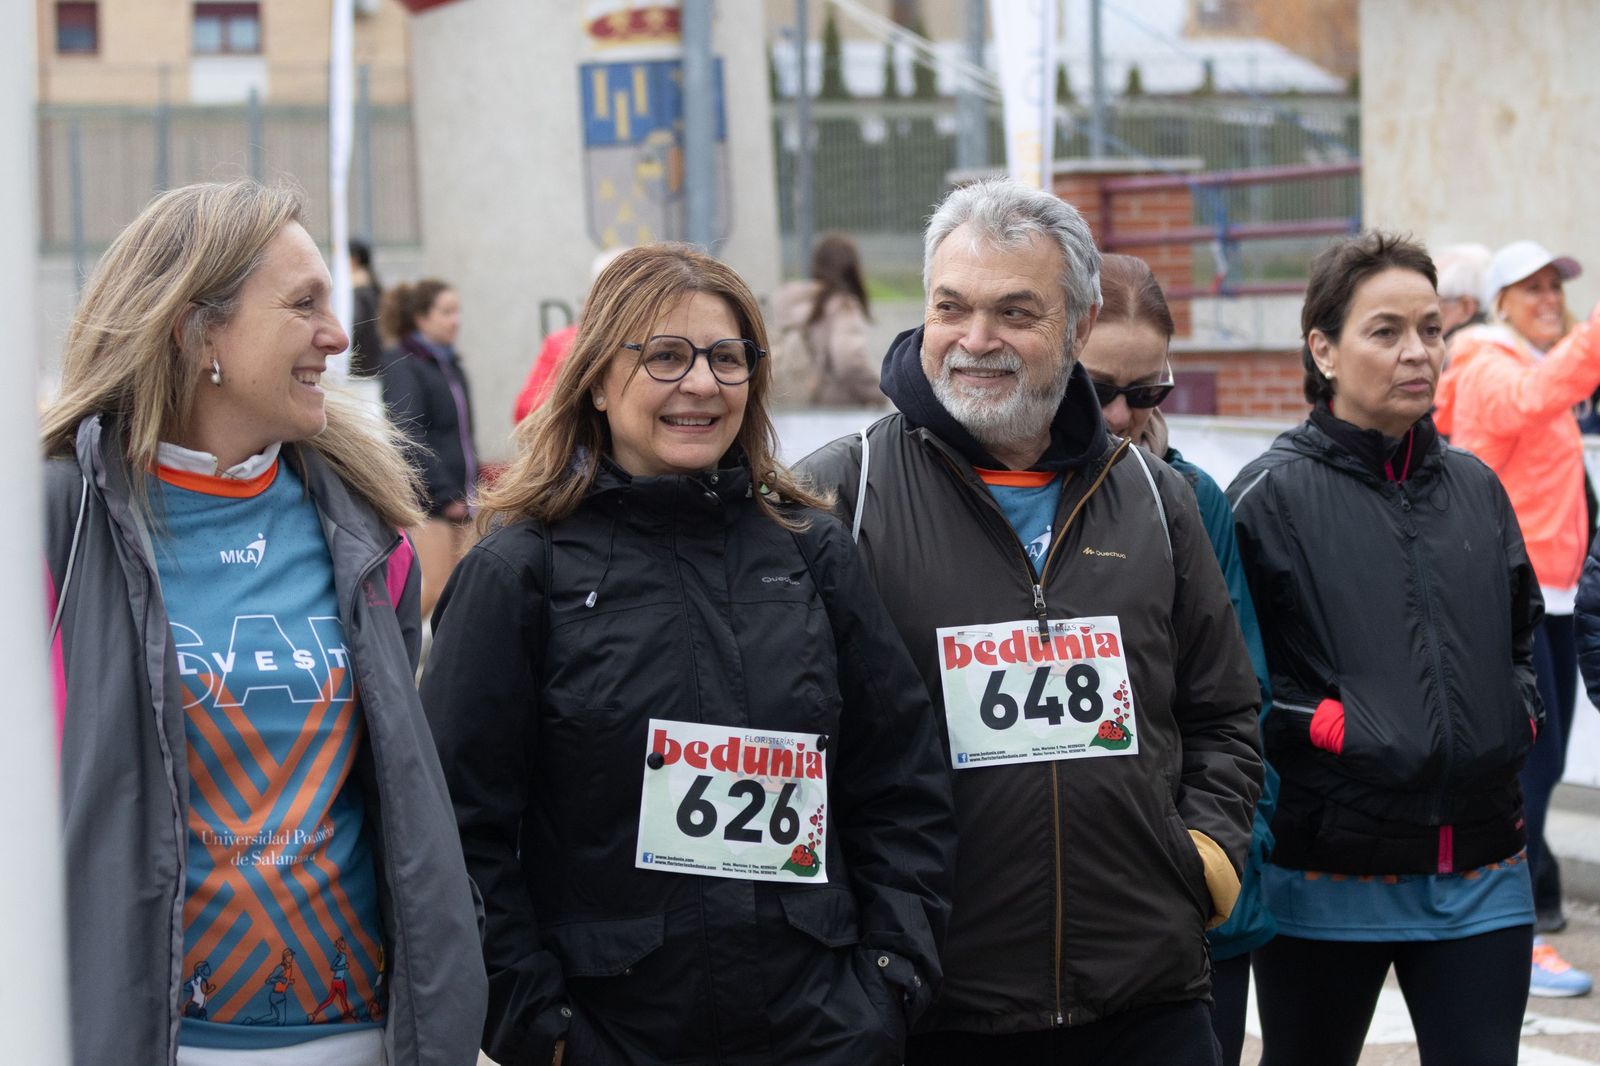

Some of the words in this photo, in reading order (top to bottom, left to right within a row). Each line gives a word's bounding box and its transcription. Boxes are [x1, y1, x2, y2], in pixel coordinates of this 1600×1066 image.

[220, 550, 257, 564] MKA
[943, 626, 1121, 670] bedunia
[980, 664, 1104, 730] 648
[652, 729, 823, 780] bedunia
[676, 774, 800, 845] 626
[202, 829, 290, 846] Universidad
[230, 852, 249, 866] de
